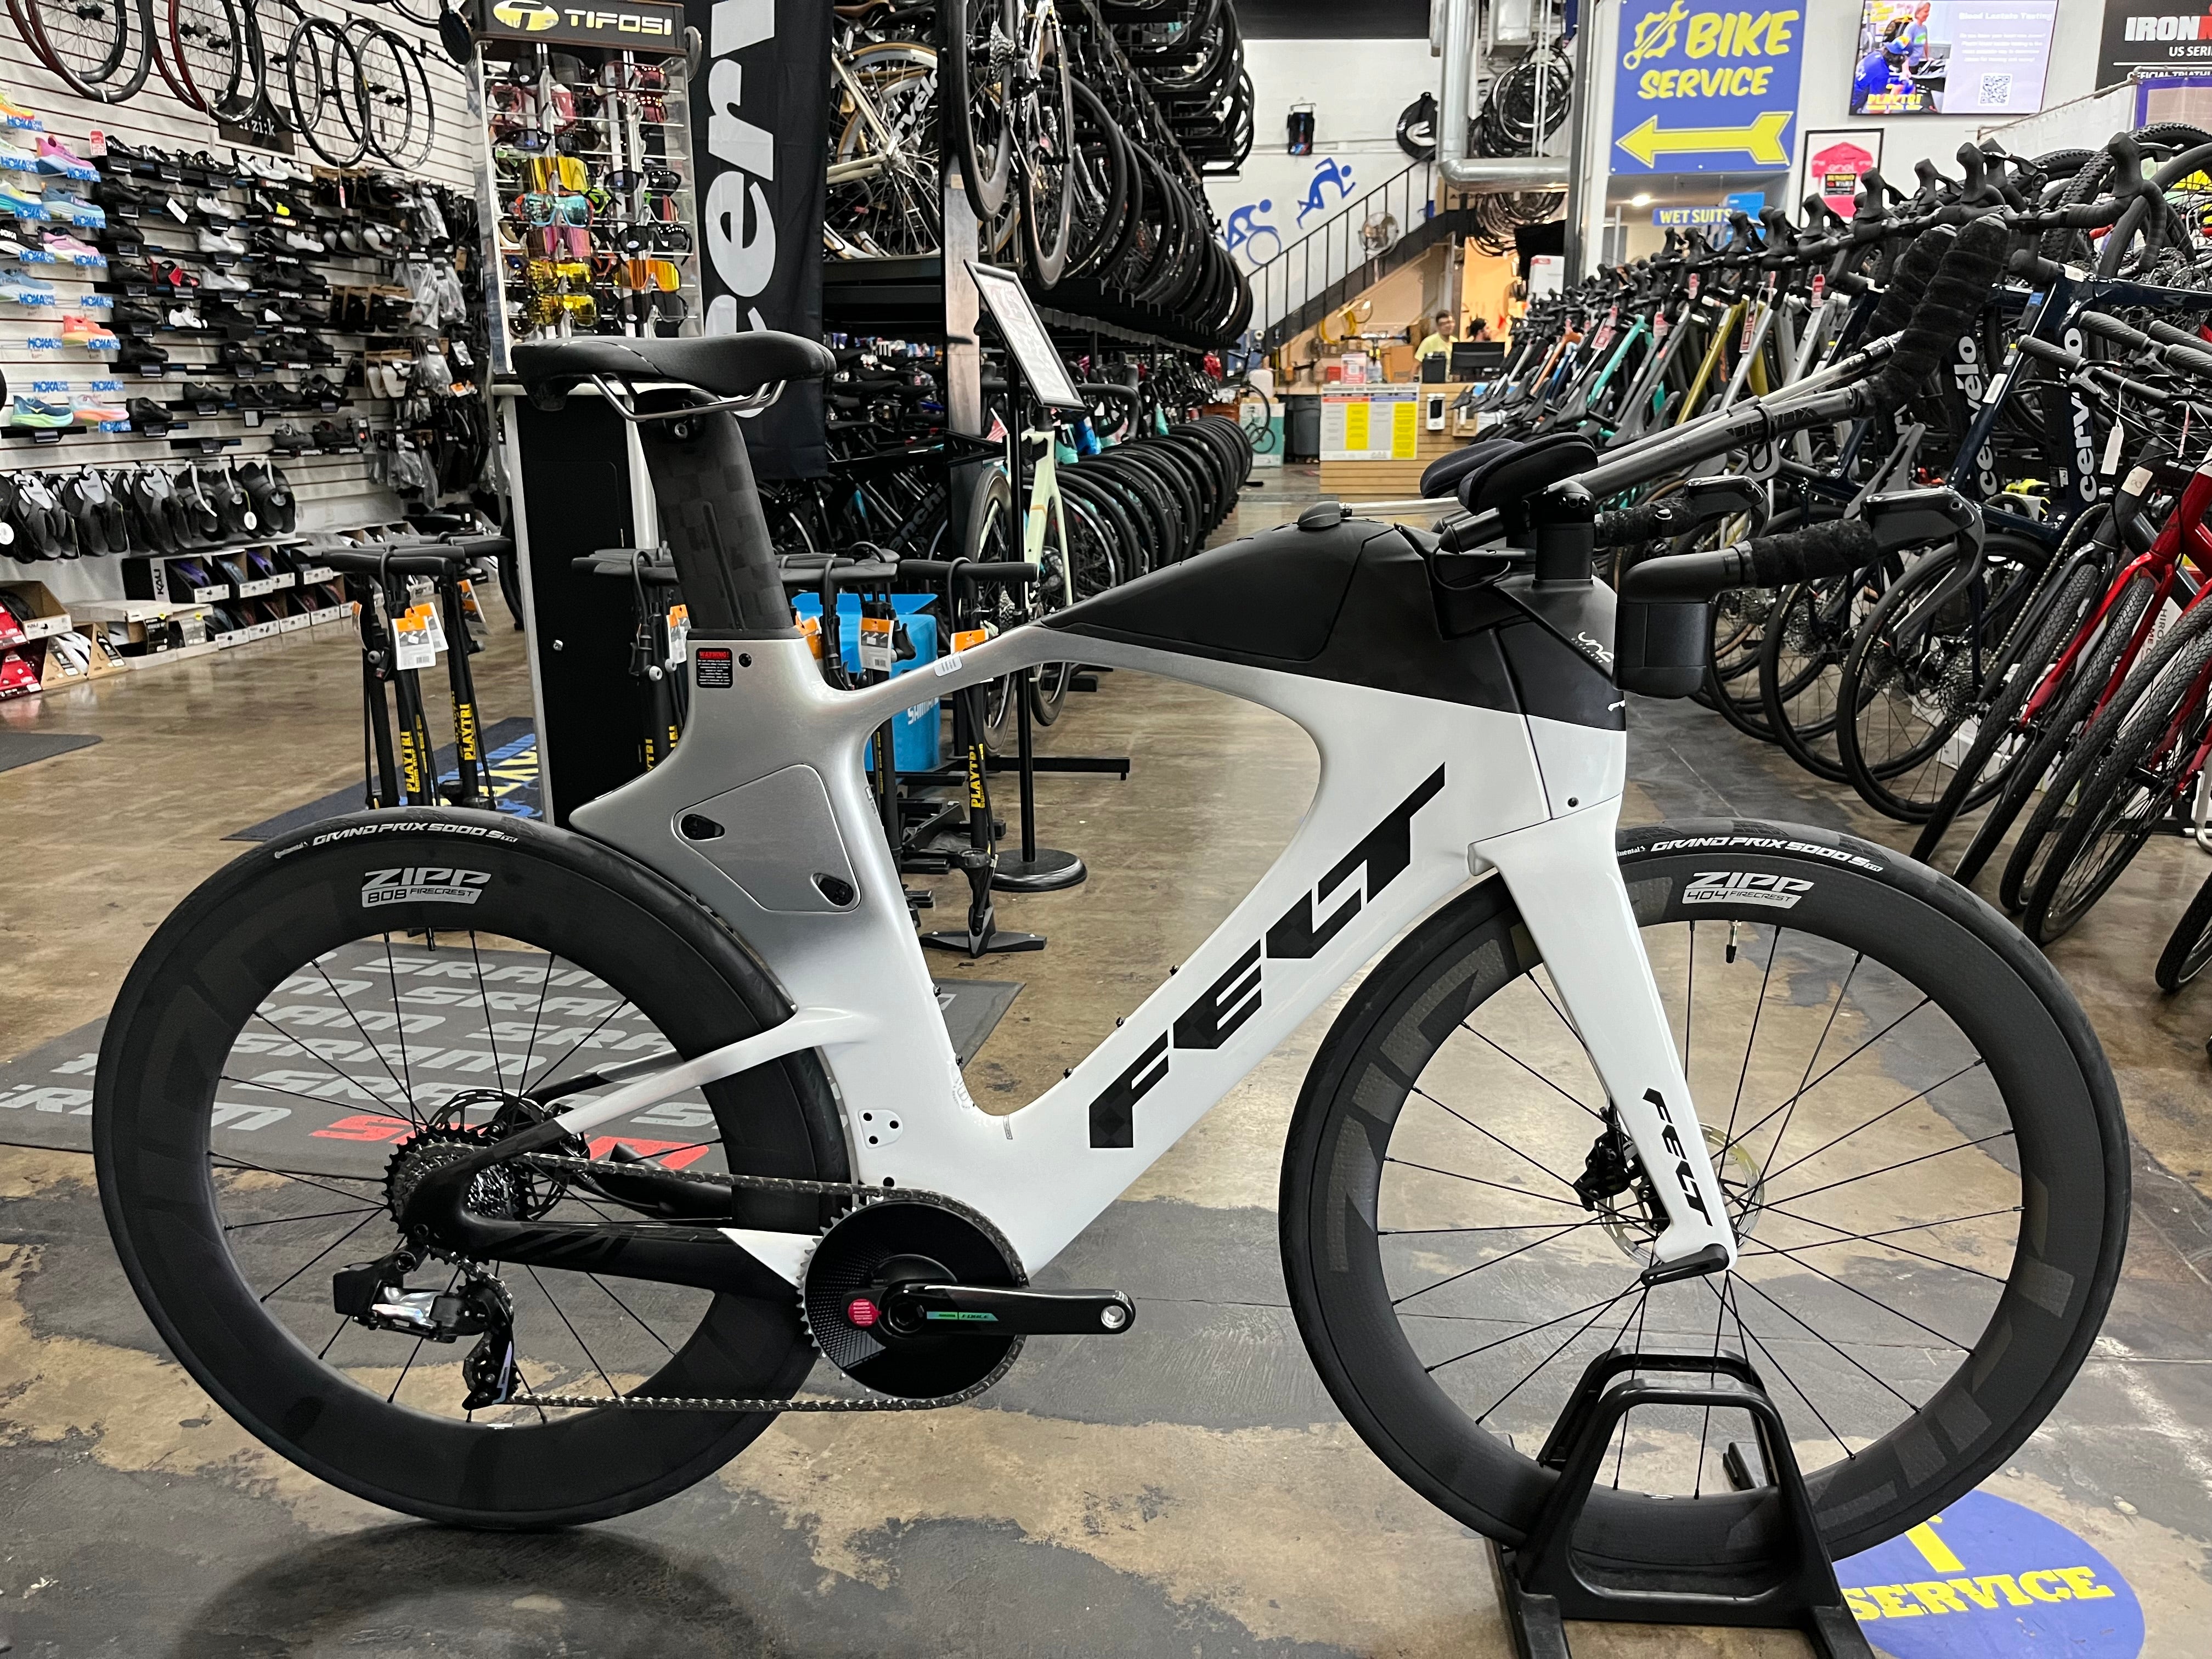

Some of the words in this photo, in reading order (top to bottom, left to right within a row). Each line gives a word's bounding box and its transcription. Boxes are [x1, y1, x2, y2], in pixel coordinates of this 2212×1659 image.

[564, 9, 672, 36] TIFOSI
[1685, 10, 1799, 59] BIKE
[2169, 46, 2185, 57] US
[2186, 46, 2212, 57] SERI
[1637, 66, 1773, 99] SERVICE
[1660, 208, 1691, 224] WET
[1691, 208, 1733, 223] SUITS
[154, 569, 163, 595] KALI
[459, 703, 474, 760] PLAYTRI
[400, 731, 416, 792] PLAYTRI
[969, 746, 981, 808] PLAYTRI
[313, 824, 376, 846] GRAND
[379, 822, 430, 833] PRIX
[428, 823, 484, 837] 5000
[1650, 837, 1729, 852] GRAND
[1728, 837, 1788, 849] PRIX
[1784, 842, 1852, 862] 5000
[362, 867, 492, 890] ZIPP
[1686, 871, 1814, 893] ZIPP
[368, 889, 407, 903] 808
[410, 888, 474, 897] FIRECREST
[1686, 889, 1729, 900] 404
[1729, 889, 1793, 902] FIRECREST
[1089, 761, 1446, 1148] FELT
[1642, 1087, 1713, 1227] FELT
[1842, 1566, 2115, 1621] SERVICE
